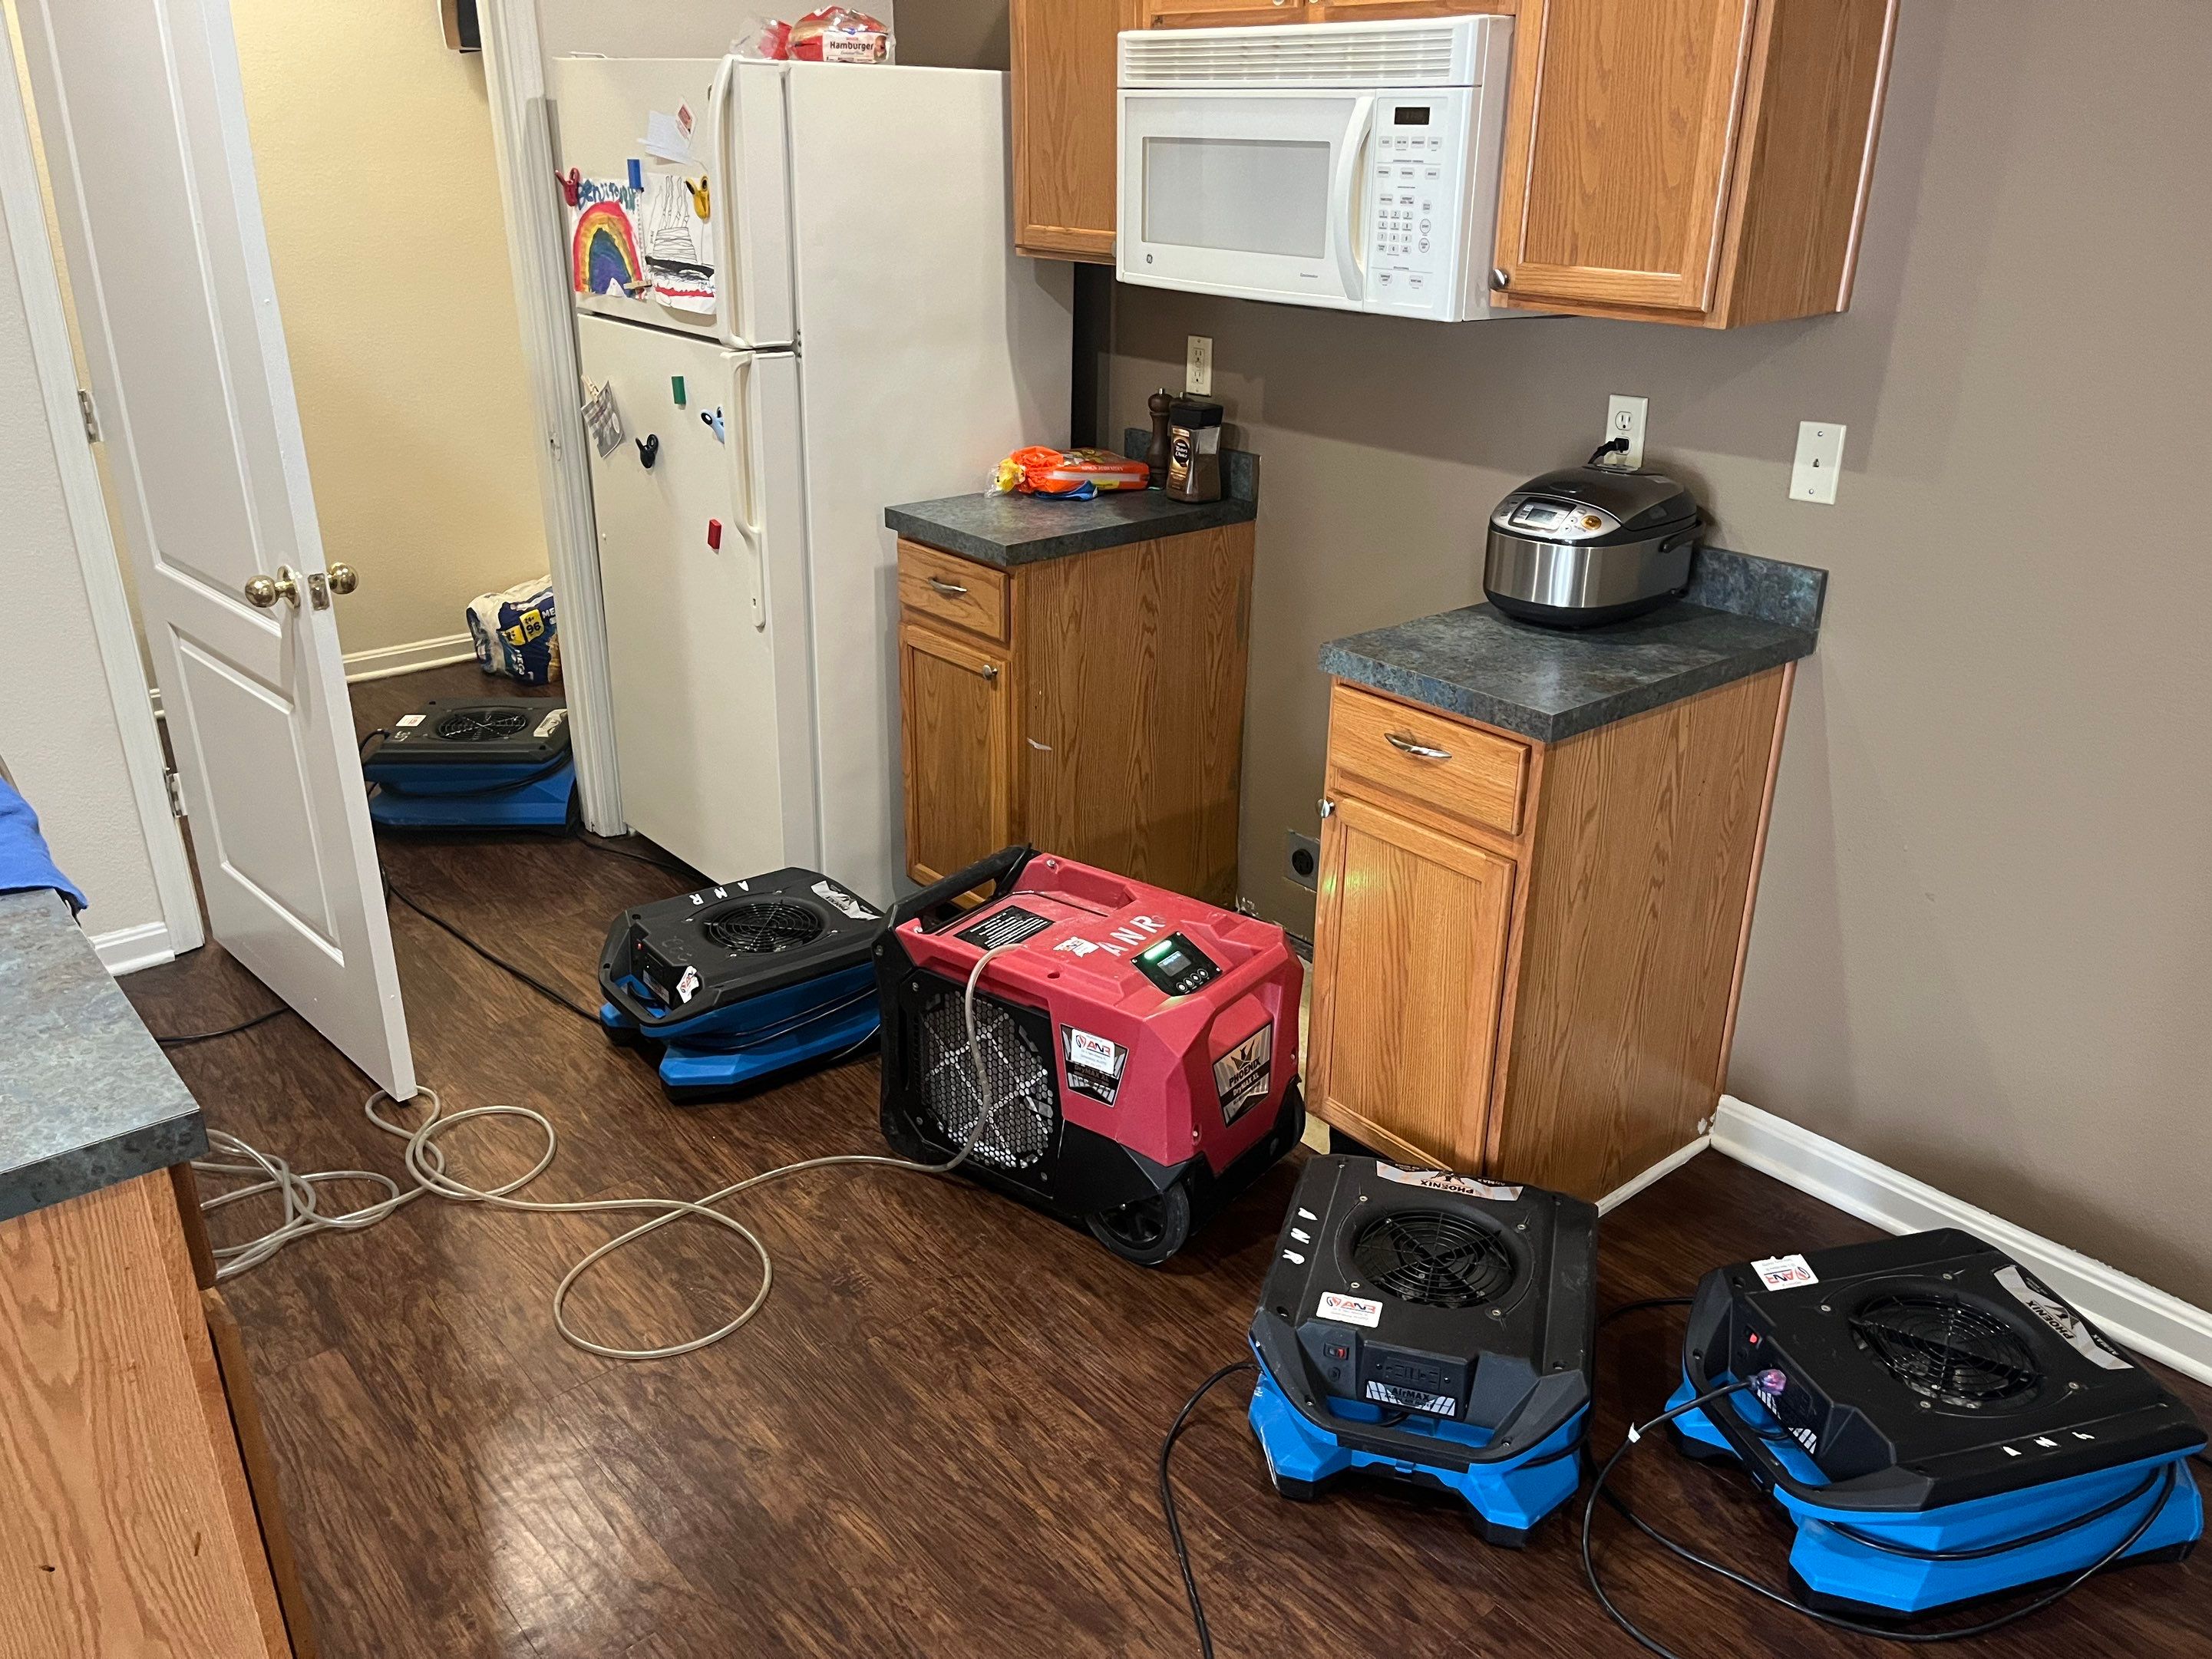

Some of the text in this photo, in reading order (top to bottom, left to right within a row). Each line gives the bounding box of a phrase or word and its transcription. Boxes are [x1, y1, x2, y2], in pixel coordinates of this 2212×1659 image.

[830, 41, 874, 51] Hamburger
[526, 621, 541, 634] 96
[1097, 915, 1166, 957] ANR
[1229, 1057, 1261, 1087] PHOENIX
[1420, 1179, 1474, 1194] PHOENIX
[2025, 1300, 2074, 1340] PHOENIX
[1391, 1387, 1430, 1401] AirMAX
